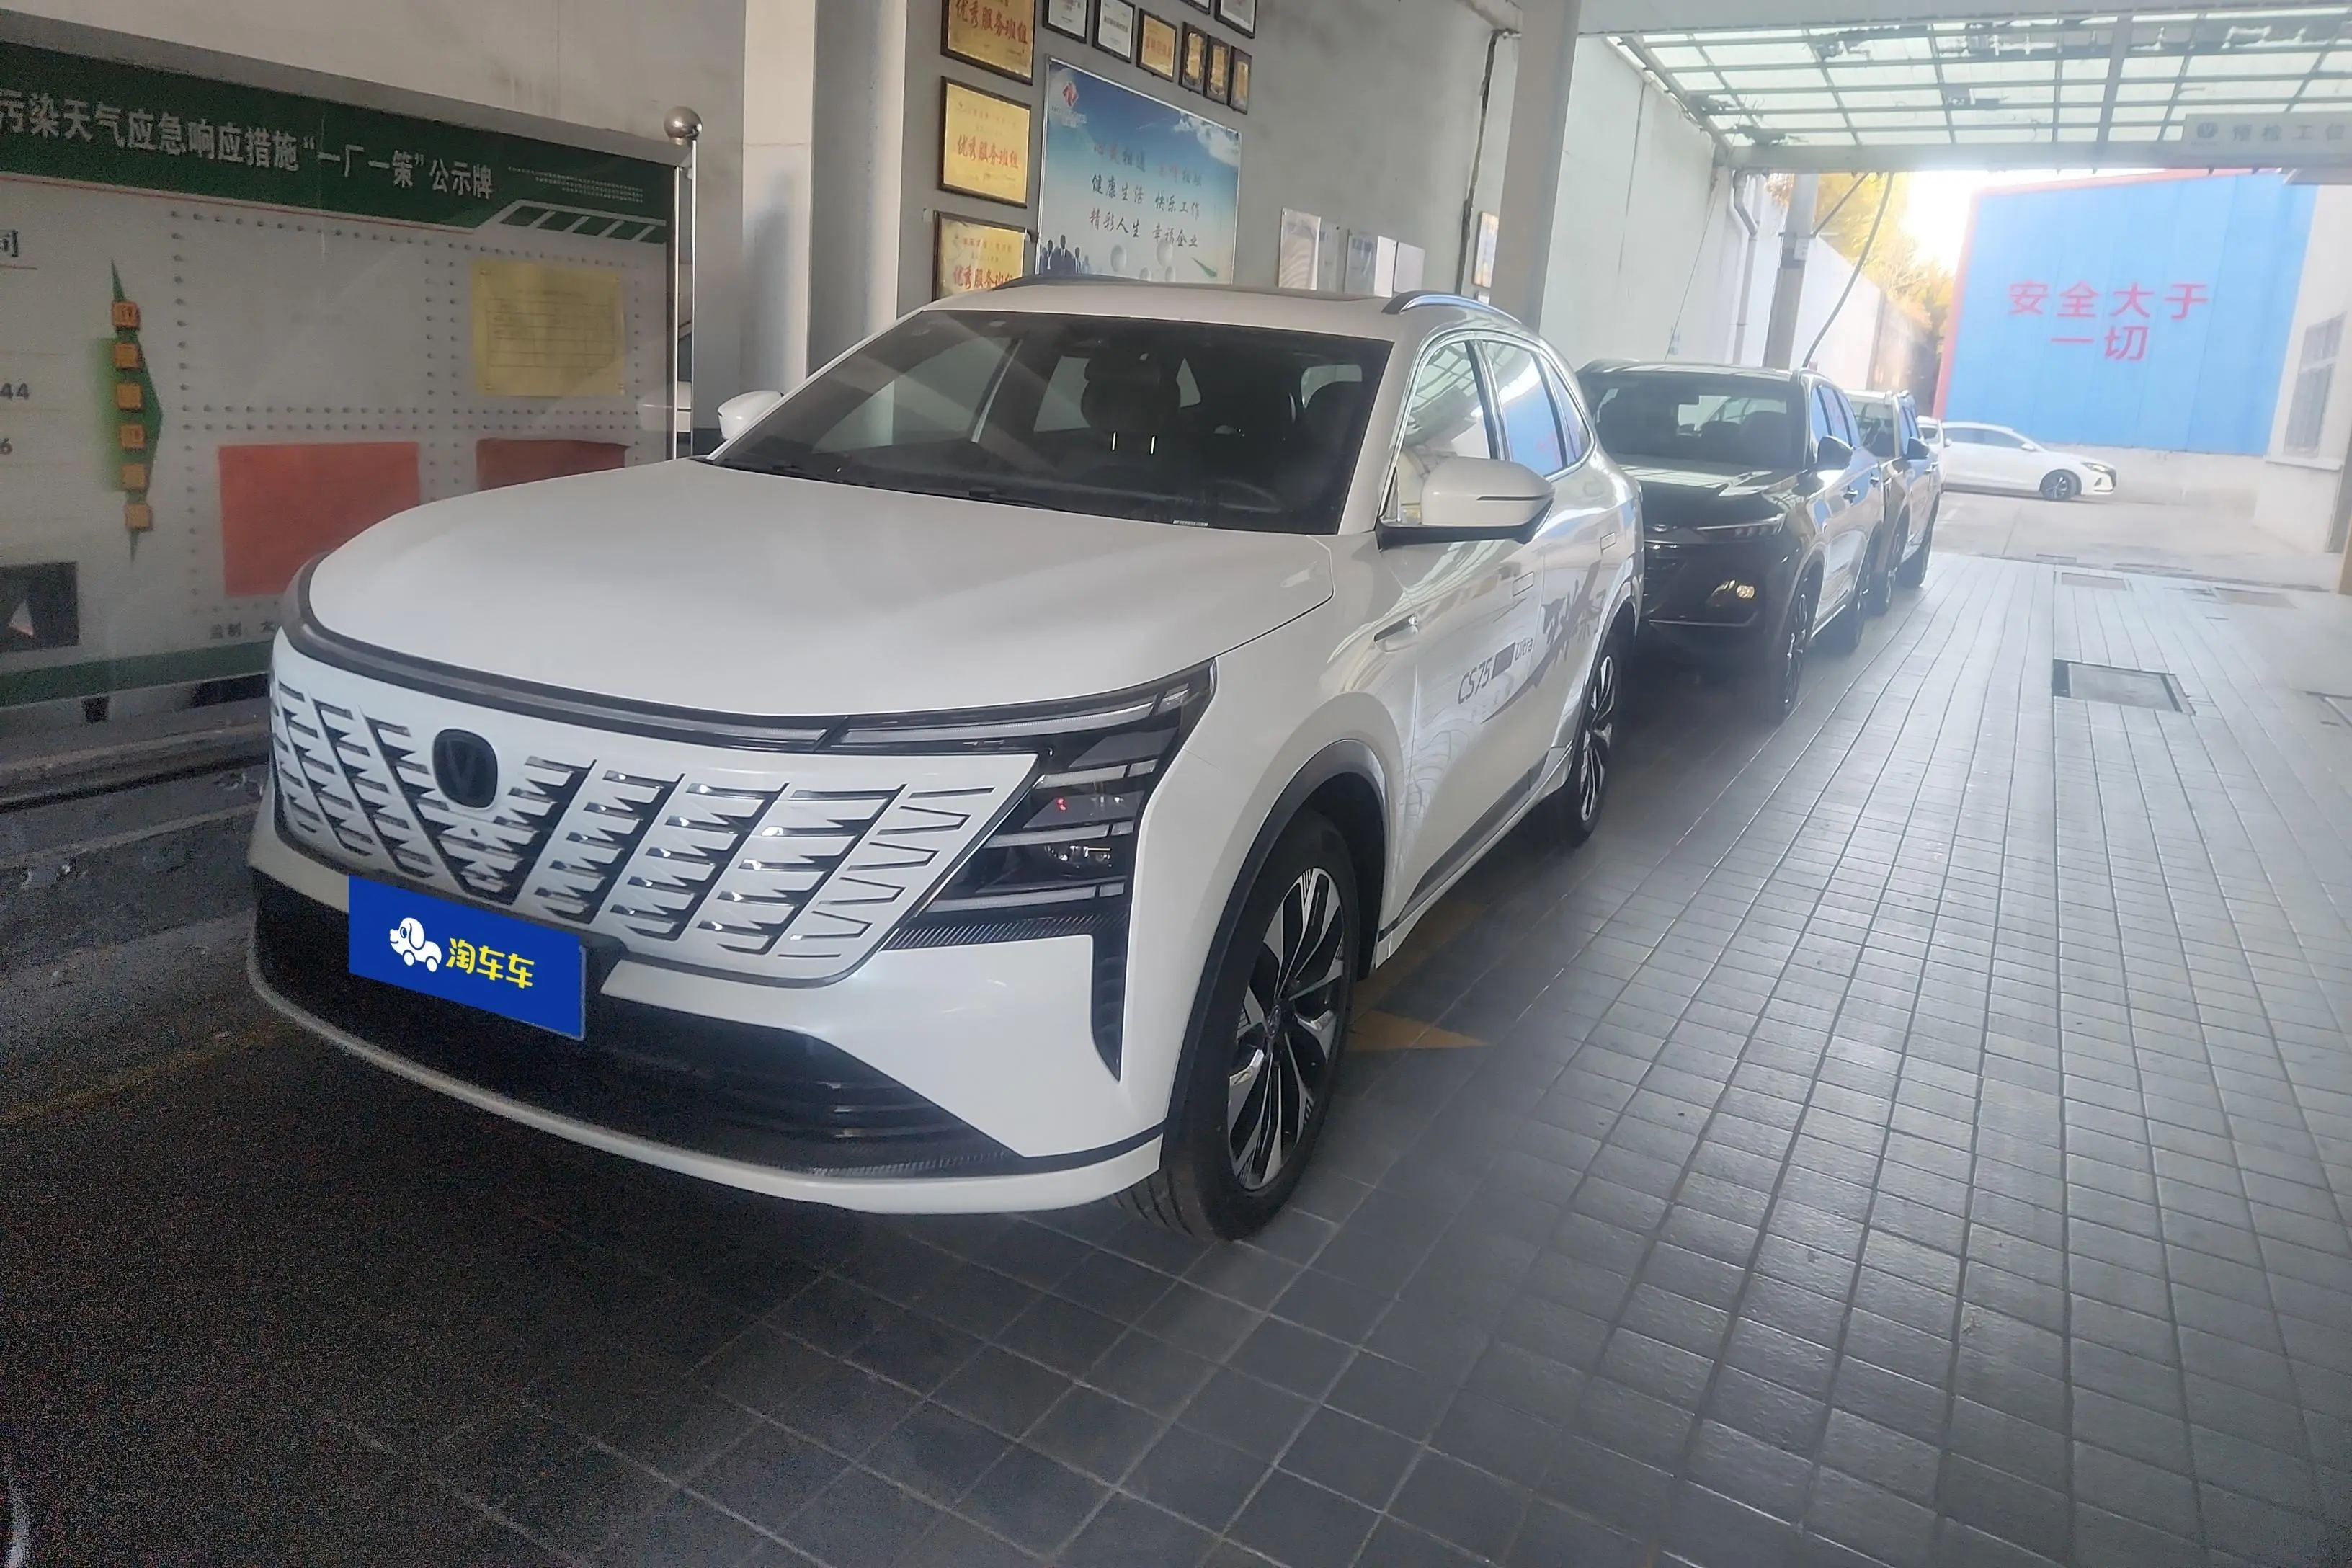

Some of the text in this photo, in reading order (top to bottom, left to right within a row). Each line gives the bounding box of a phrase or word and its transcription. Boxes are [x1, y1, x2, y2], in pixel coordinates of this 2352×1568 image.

[957, 133, 1018, 169] 优秀服务班组
[1092, 172, 1200, 219] 健康生活 快乐工作
[1089, 207, 1198, 247] 精彩人生 幸福企业
[2007, 279, 2209, 321] 安全大于
[2050, 326, 2150, 361] 一切
[1457, 656, 1494, 705] CS75
